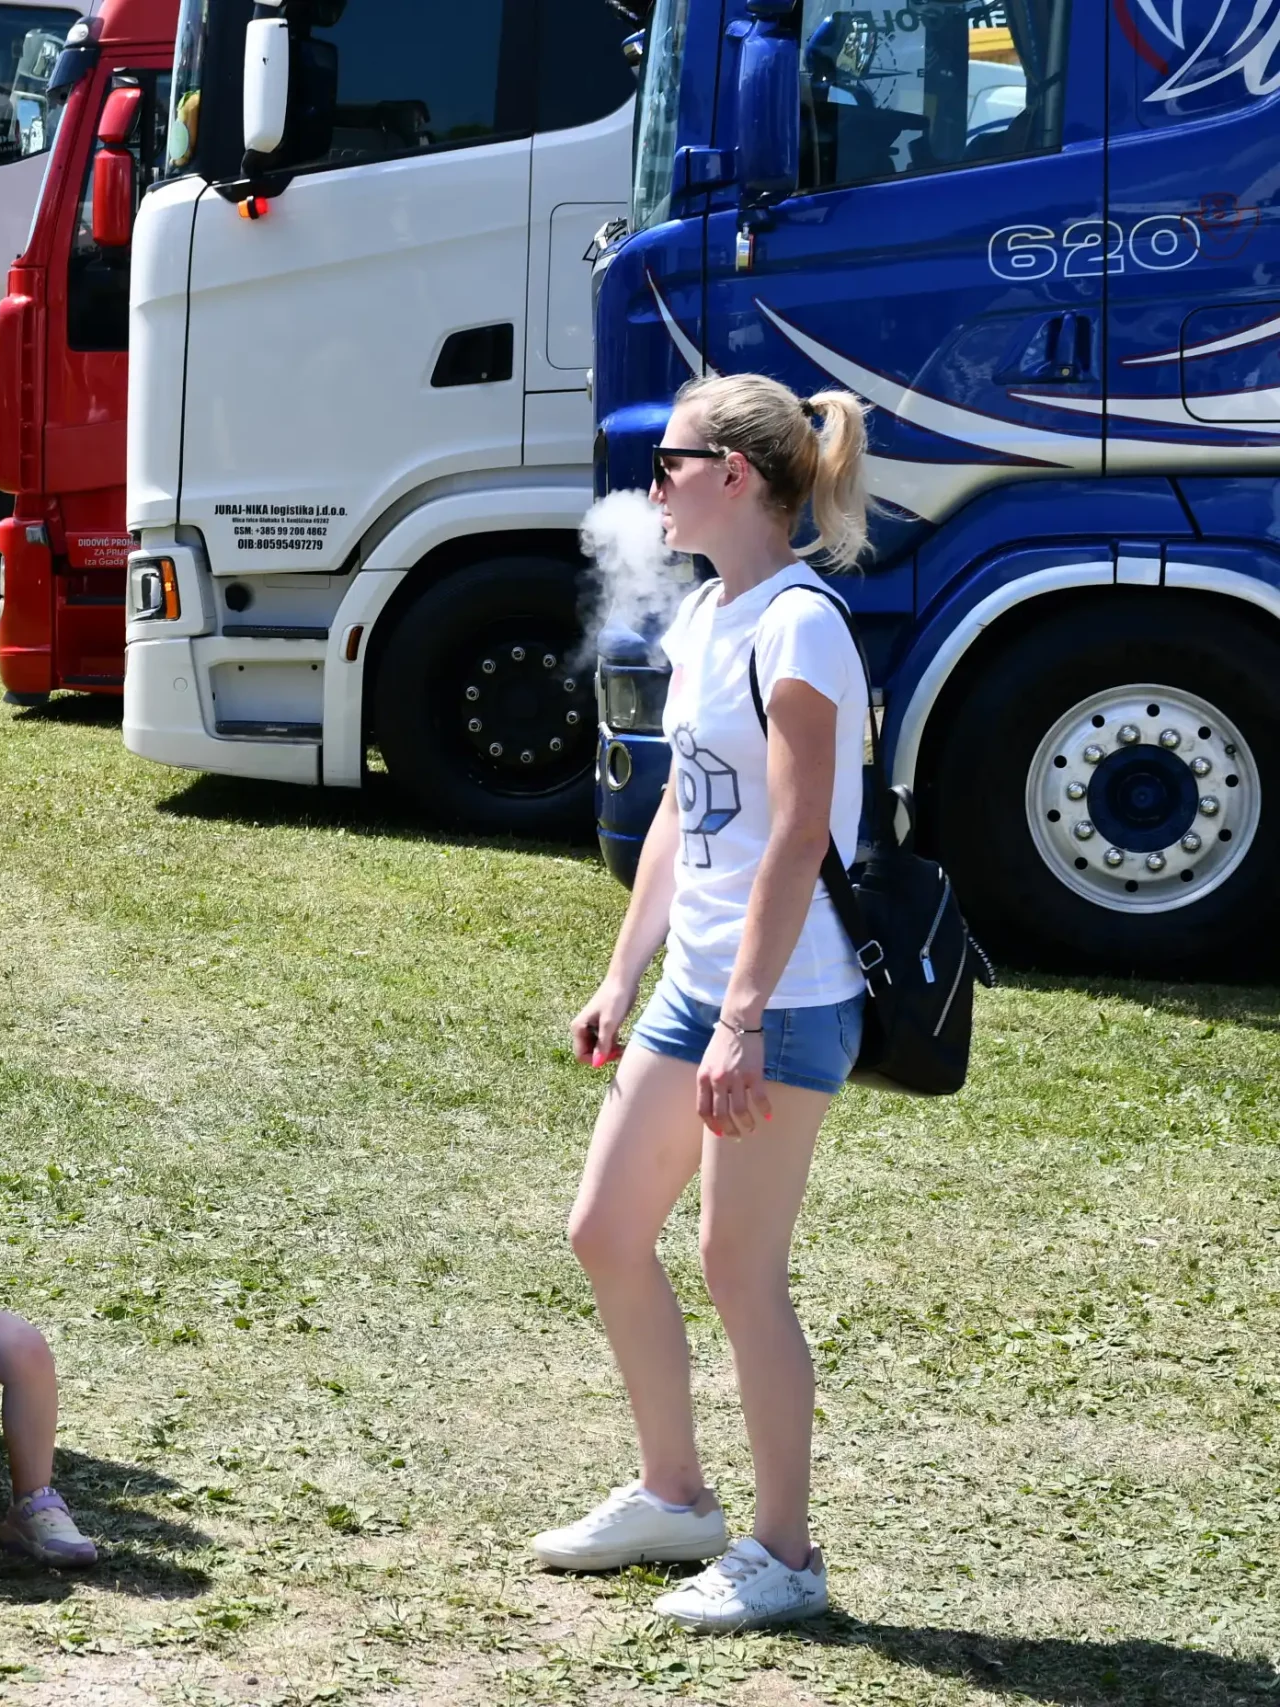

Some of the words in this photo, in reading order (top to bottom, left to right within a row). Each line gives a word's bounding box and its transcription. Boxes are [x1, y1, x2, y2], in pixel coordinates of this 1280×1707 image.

[988, 214, 1201, 281] 620
[214, 504, 269, 515] JURAJ-NIKA
[270, 504, 314, 516] logistika
[315, 505, 348, 516] j.d.o.o.
[234, 526, 253, 536] GSM:
[255, 526, 276, 536] +385
[277, 526, 288, 536] 99
[289, 526, 305, 536] 200
[307, 526, 328, 537] 4862
[78, 537, 109, 547] DIDOVIĆ
[237, 538, 323, 550] OIB:80595497279
[94, 548, 105, 556] ZA
[98, 557, 124, 566] Grada
